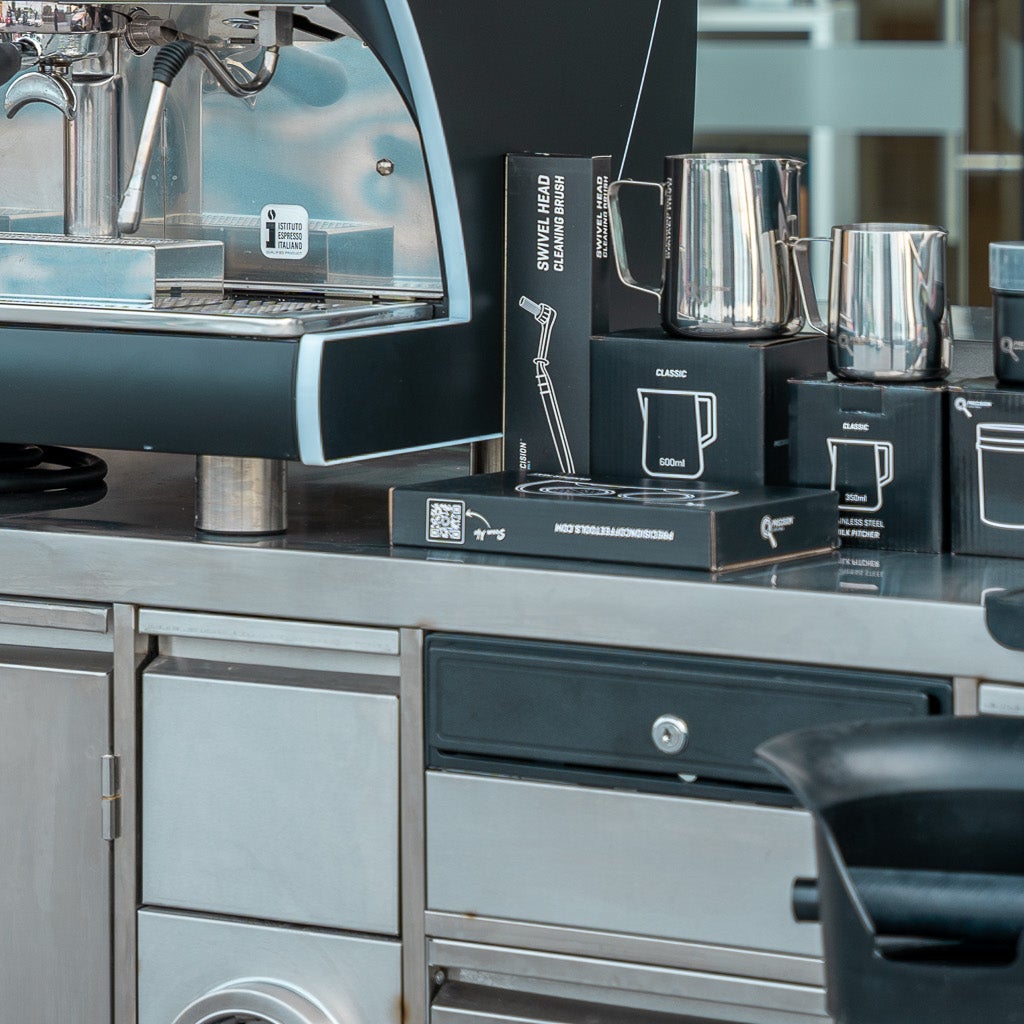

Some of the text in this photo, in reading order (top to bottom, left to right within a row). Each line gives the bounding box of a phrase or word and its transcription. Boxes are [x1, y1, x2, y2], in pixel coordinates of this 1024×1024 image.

[595, 175, 604, 259] SWIVEL HEAD
[277, 222, 303, 231] ISTITUTO
[537, 174, 551, 272] SWIVEL HEAD
[553, 175, 565, 272] CLEANING BRUSH
[277, 231, 303, 241] ESPRESSO
[277, 241, 303, 250] ITALIANO
[655, 368, 688, 378] CLASSIC
[842, 422, 870, 431] CLASSIC
[659, 457, 686, 468] 600ml
[844, 493, 868, 503] 350ml
[863, 519, 885, 528] STEEL
[554, 522, 675, 541] PRECISIONCOFFEETOOLS.COM
[850, 530, 881, 539] PITCHER
